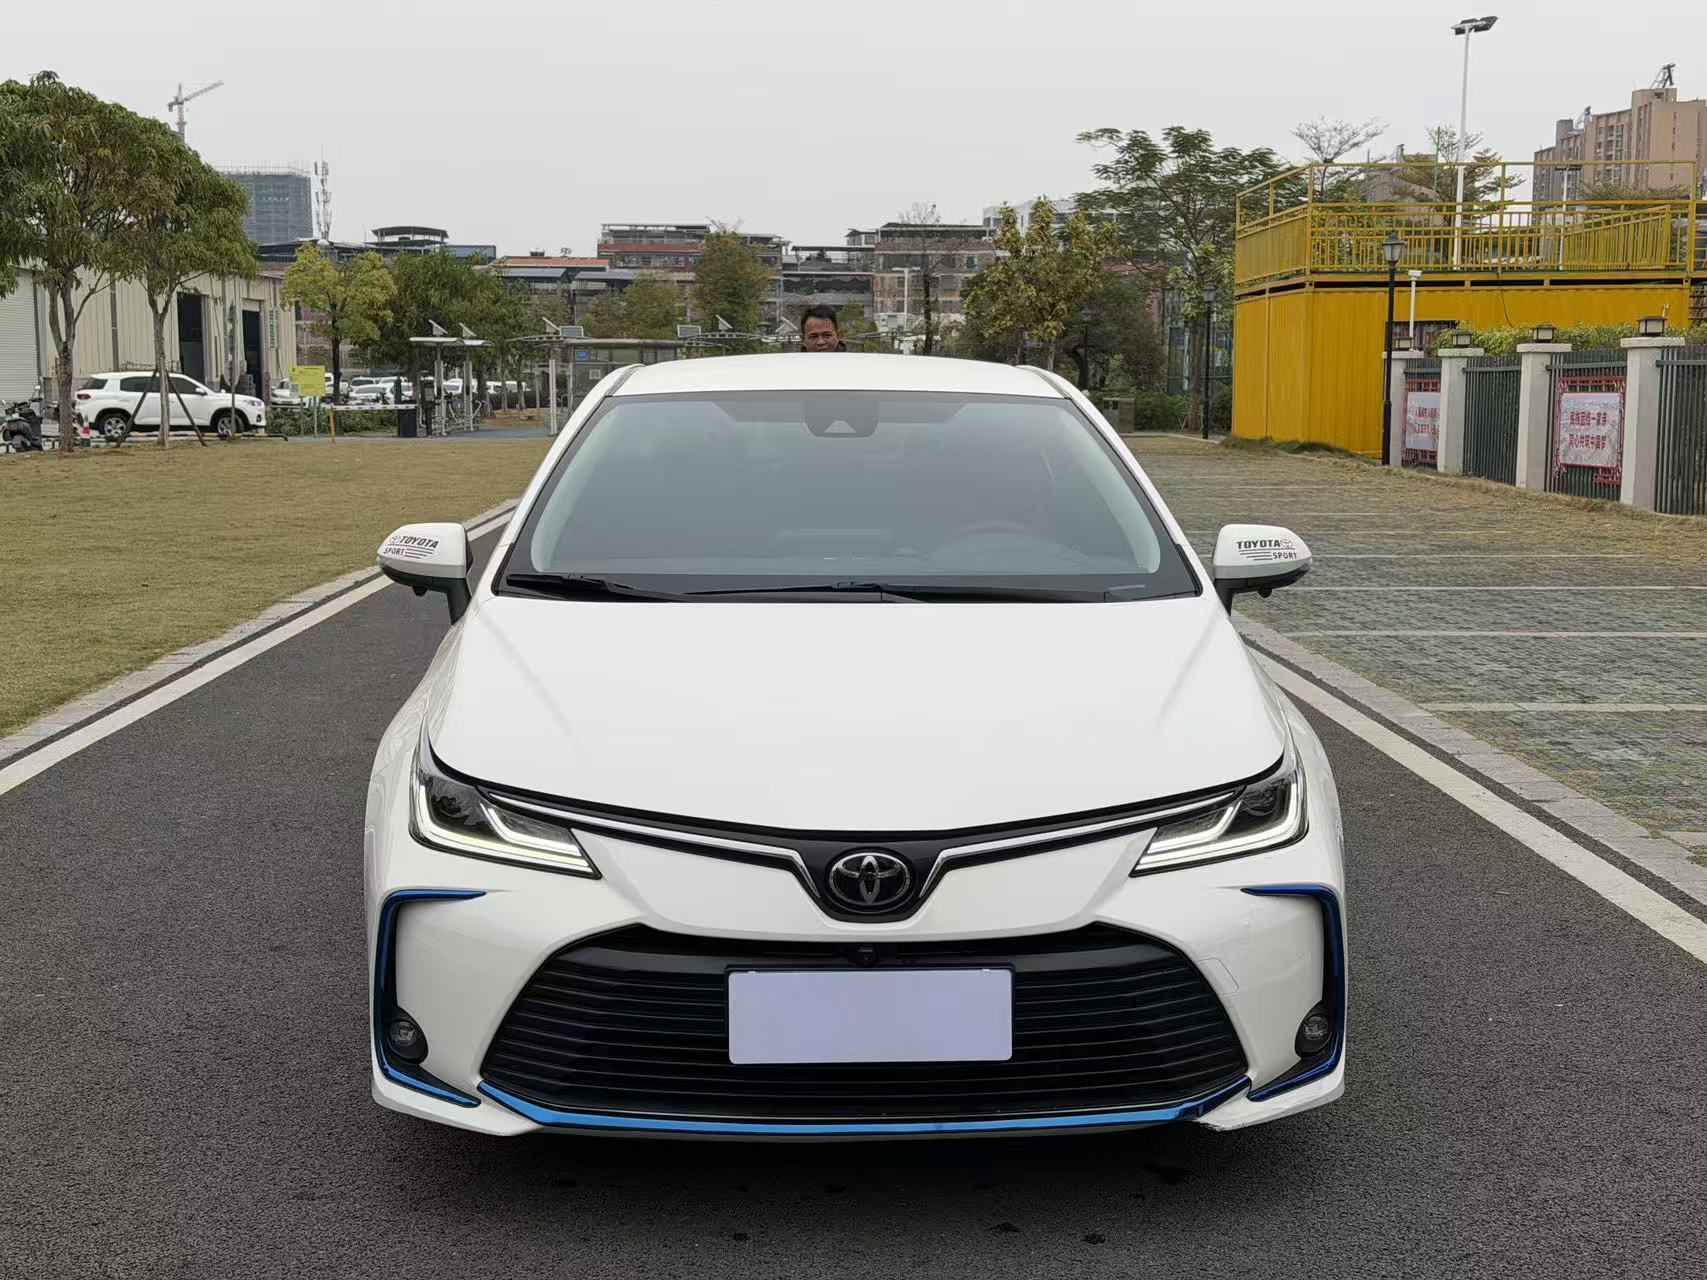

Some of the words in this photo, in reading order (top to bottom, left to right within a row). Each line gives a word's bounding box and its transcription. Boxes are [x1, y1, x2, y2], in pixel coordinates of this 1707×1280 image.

[399, 535, 439, 549] TOYOTA
[1236, 539, 1281, 549] TOYOTA
[383, 547, 405, 556] SPORT
[1272, 552, 1297, 560] SPORT
